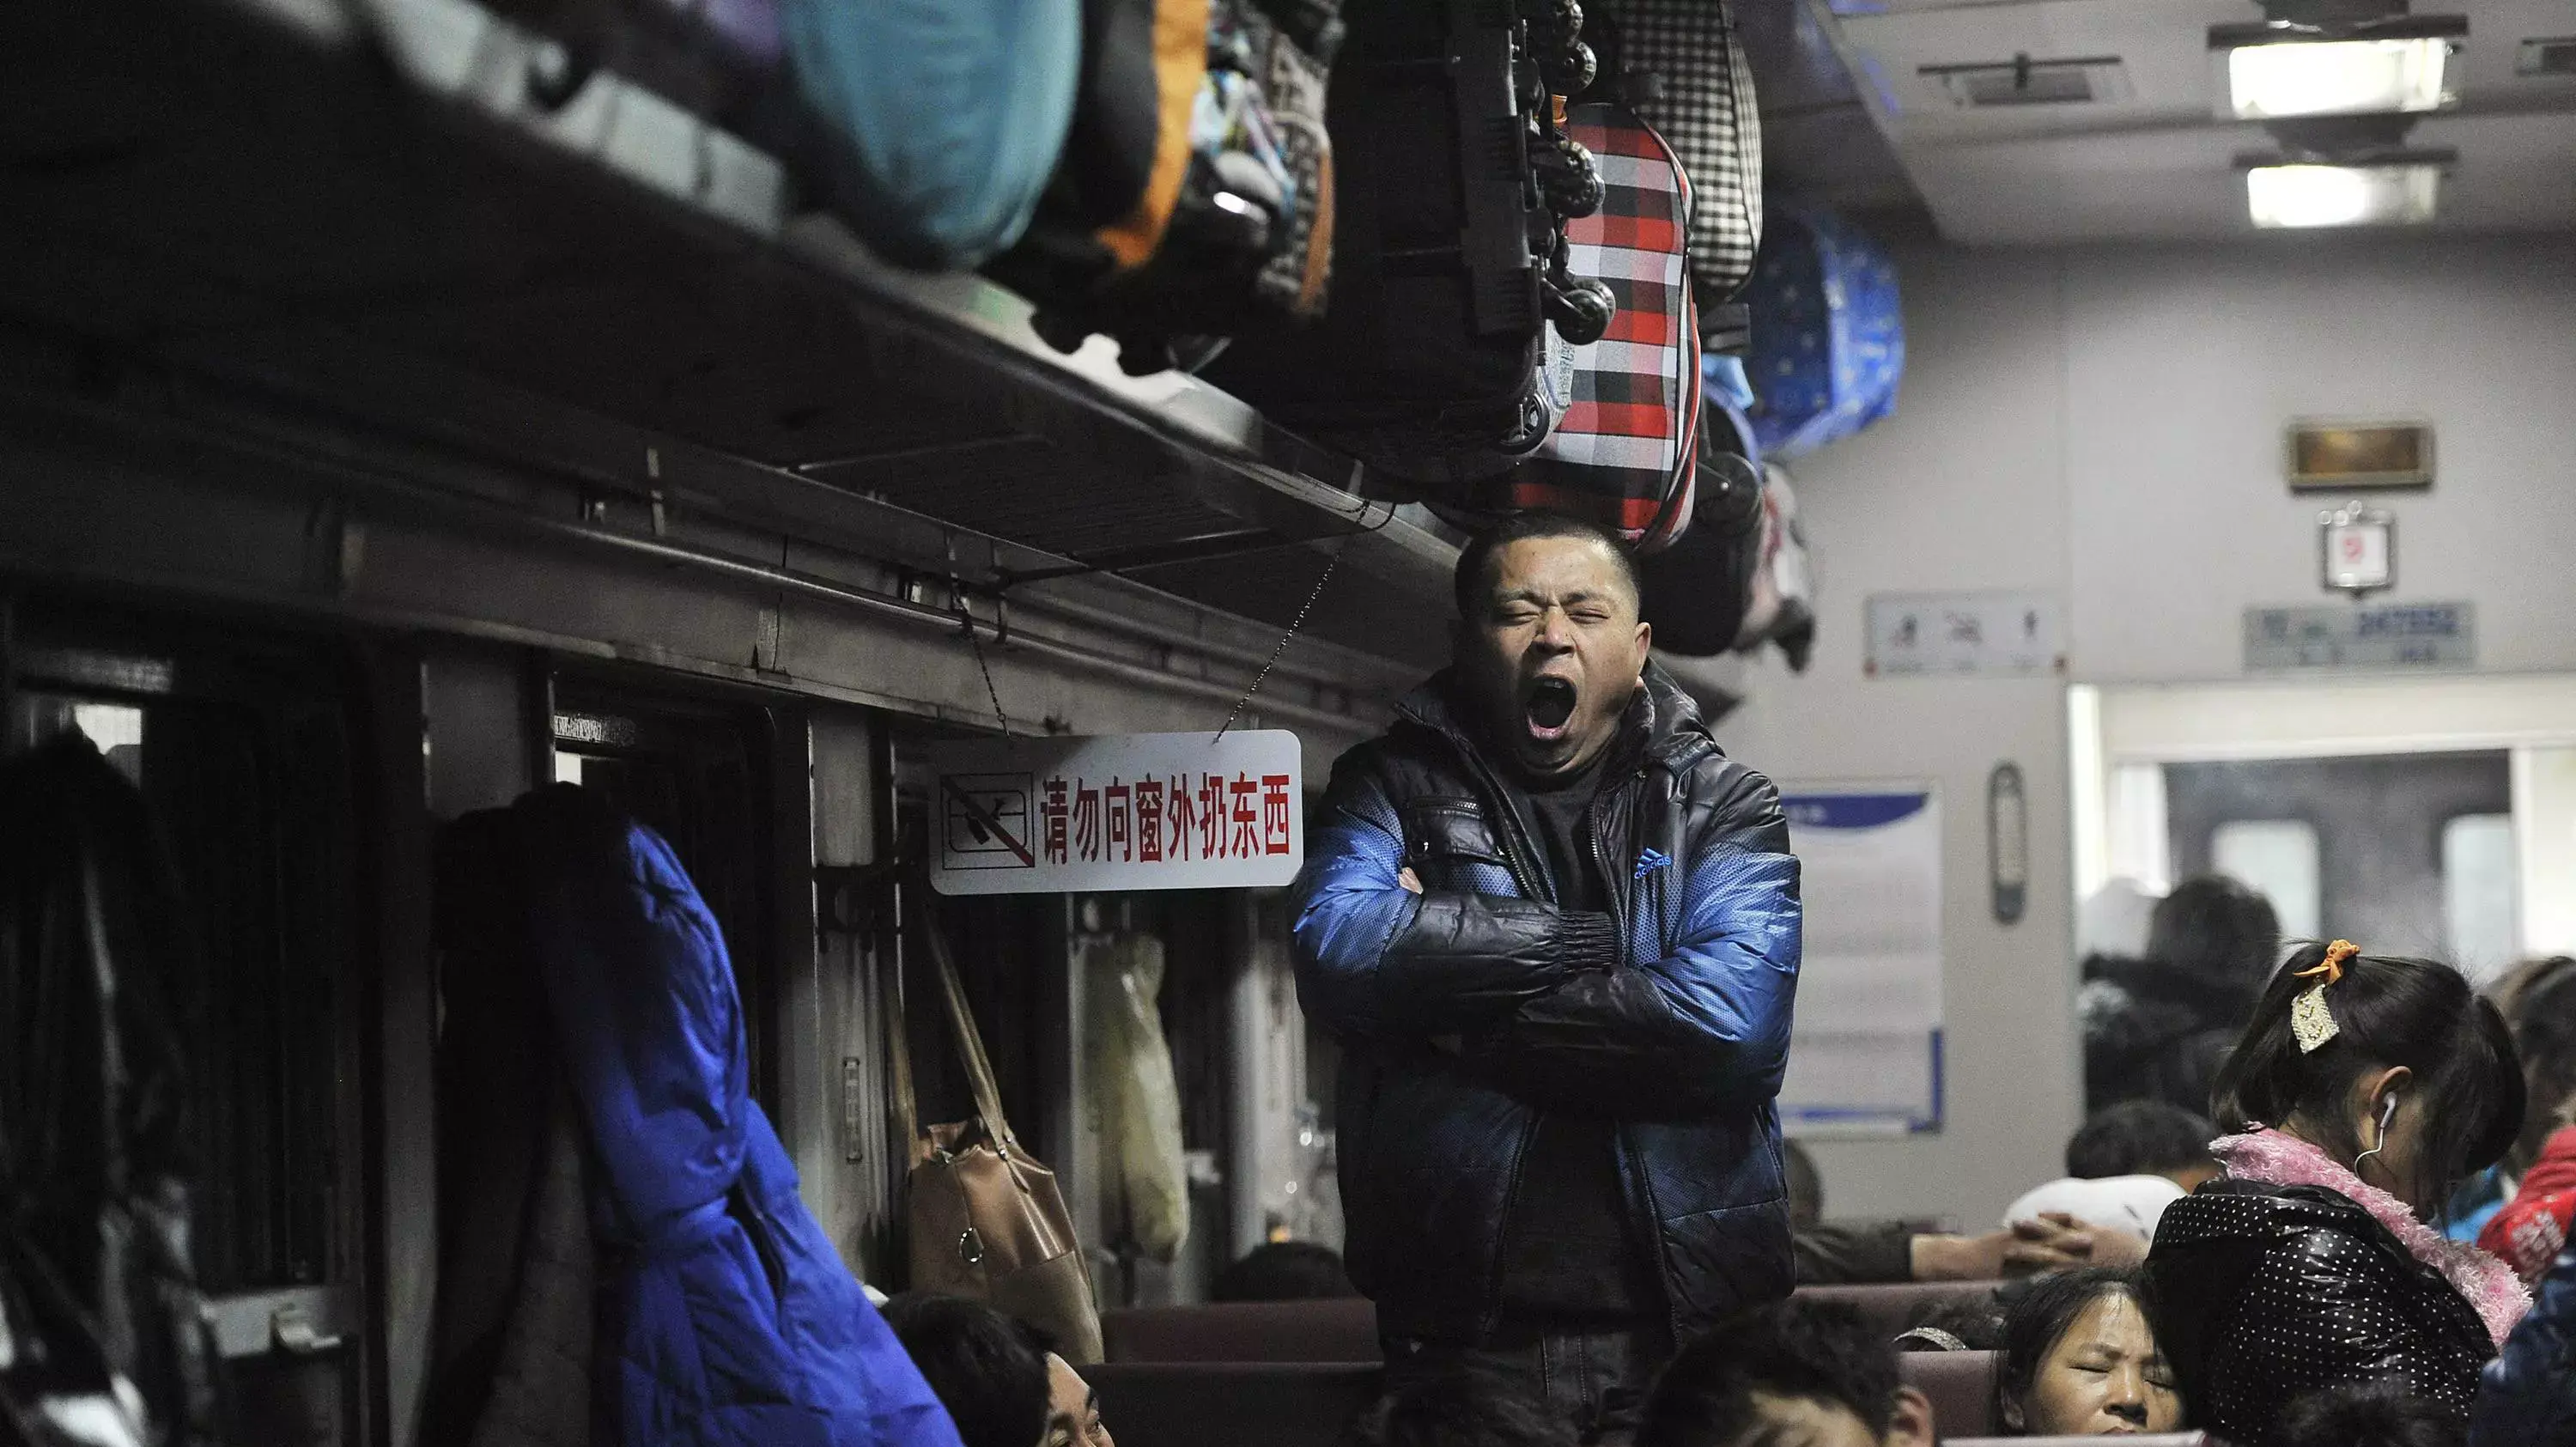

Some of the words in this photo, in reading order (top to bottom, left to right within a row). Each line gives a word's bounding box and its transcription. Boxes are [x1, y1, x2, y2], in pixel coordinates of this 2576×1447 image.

[1040, 770, 1290, 866] 请勿向窗外扔东西
[1634, 855, 1673, 879] adidas
